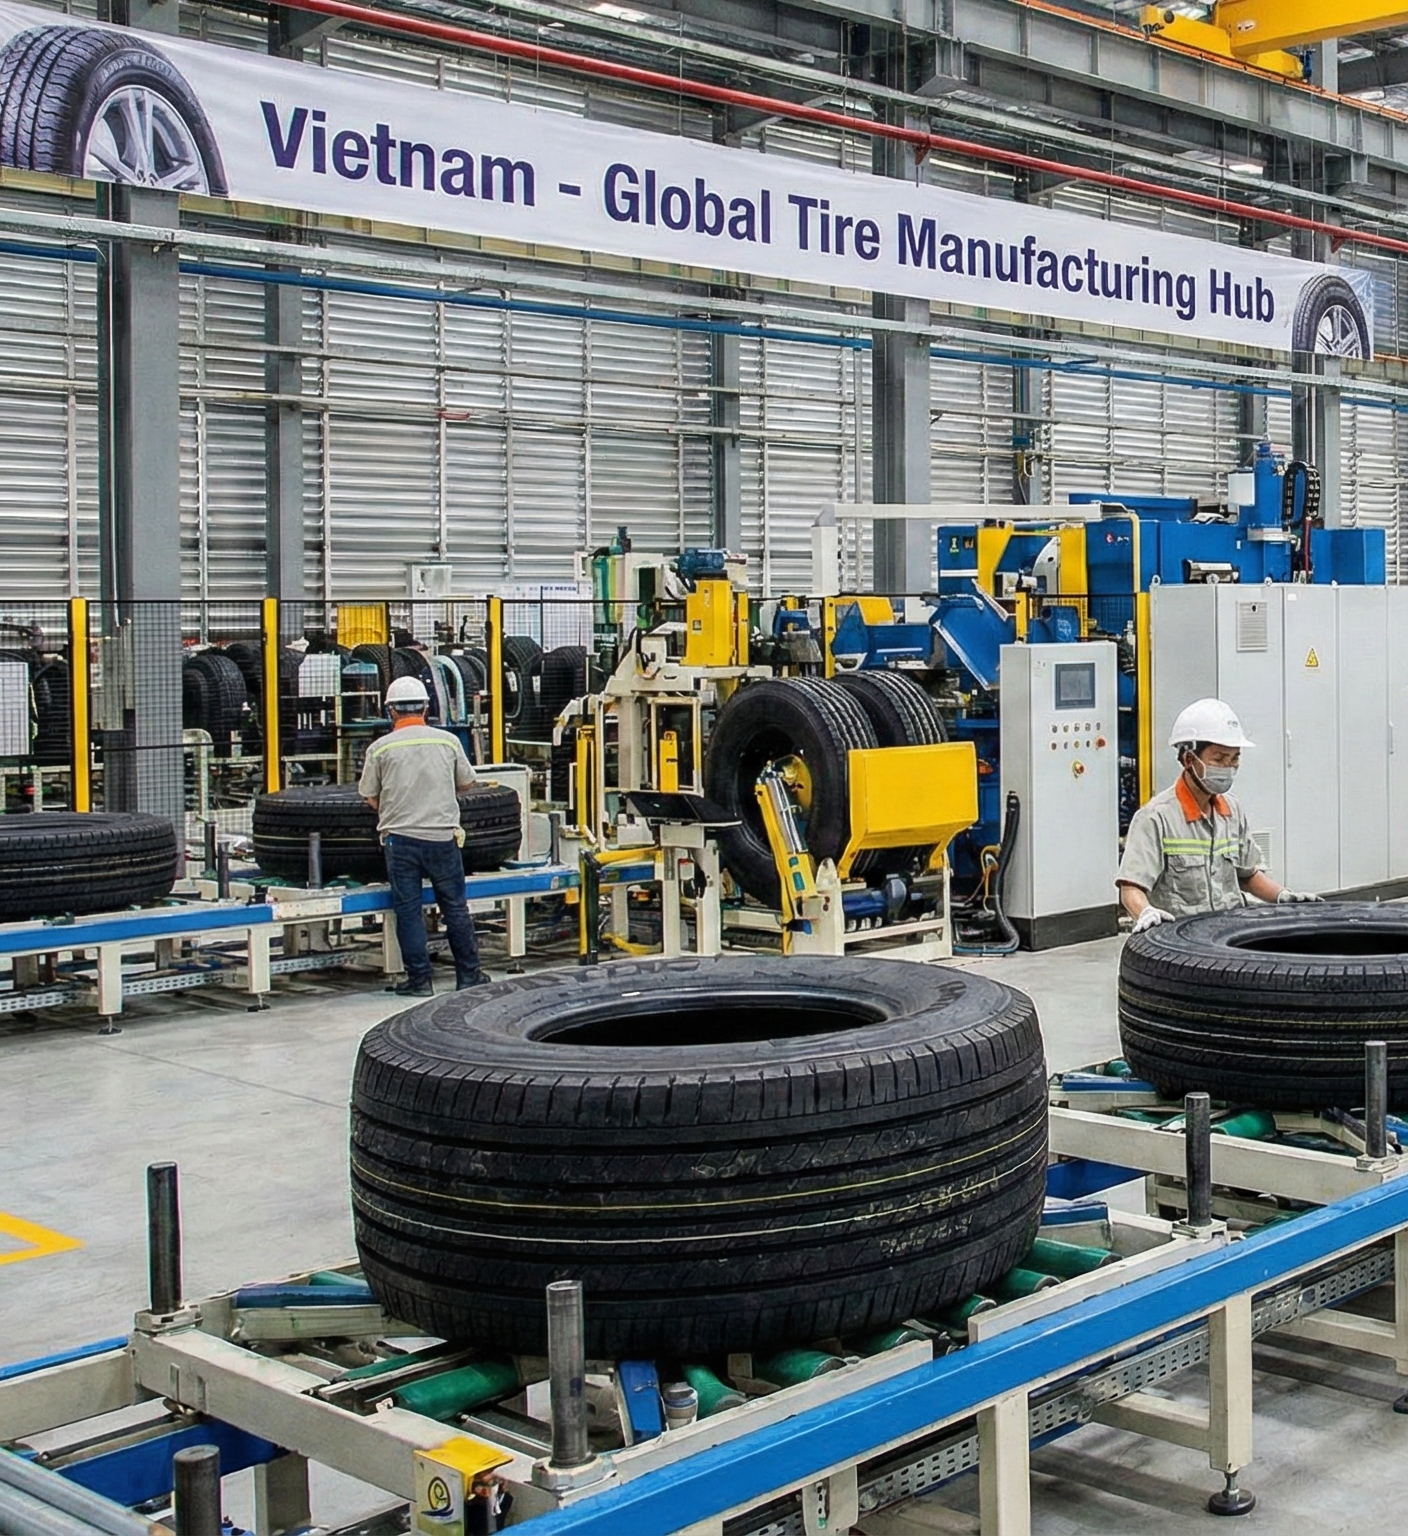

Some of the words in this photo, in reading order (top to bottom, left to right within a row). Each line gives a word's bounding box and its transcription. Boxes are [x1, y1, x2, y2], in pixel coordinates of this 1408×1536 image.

[260, 100, 536, 207] Vietnam
[558, 182, 582, 197] -
[603, 162, 772, 245] Global
[787, 193, 881, 261] Tire
[897, 212, 1197, 322] Manufacturing
[1209, 268, 1275, 324] Hub
